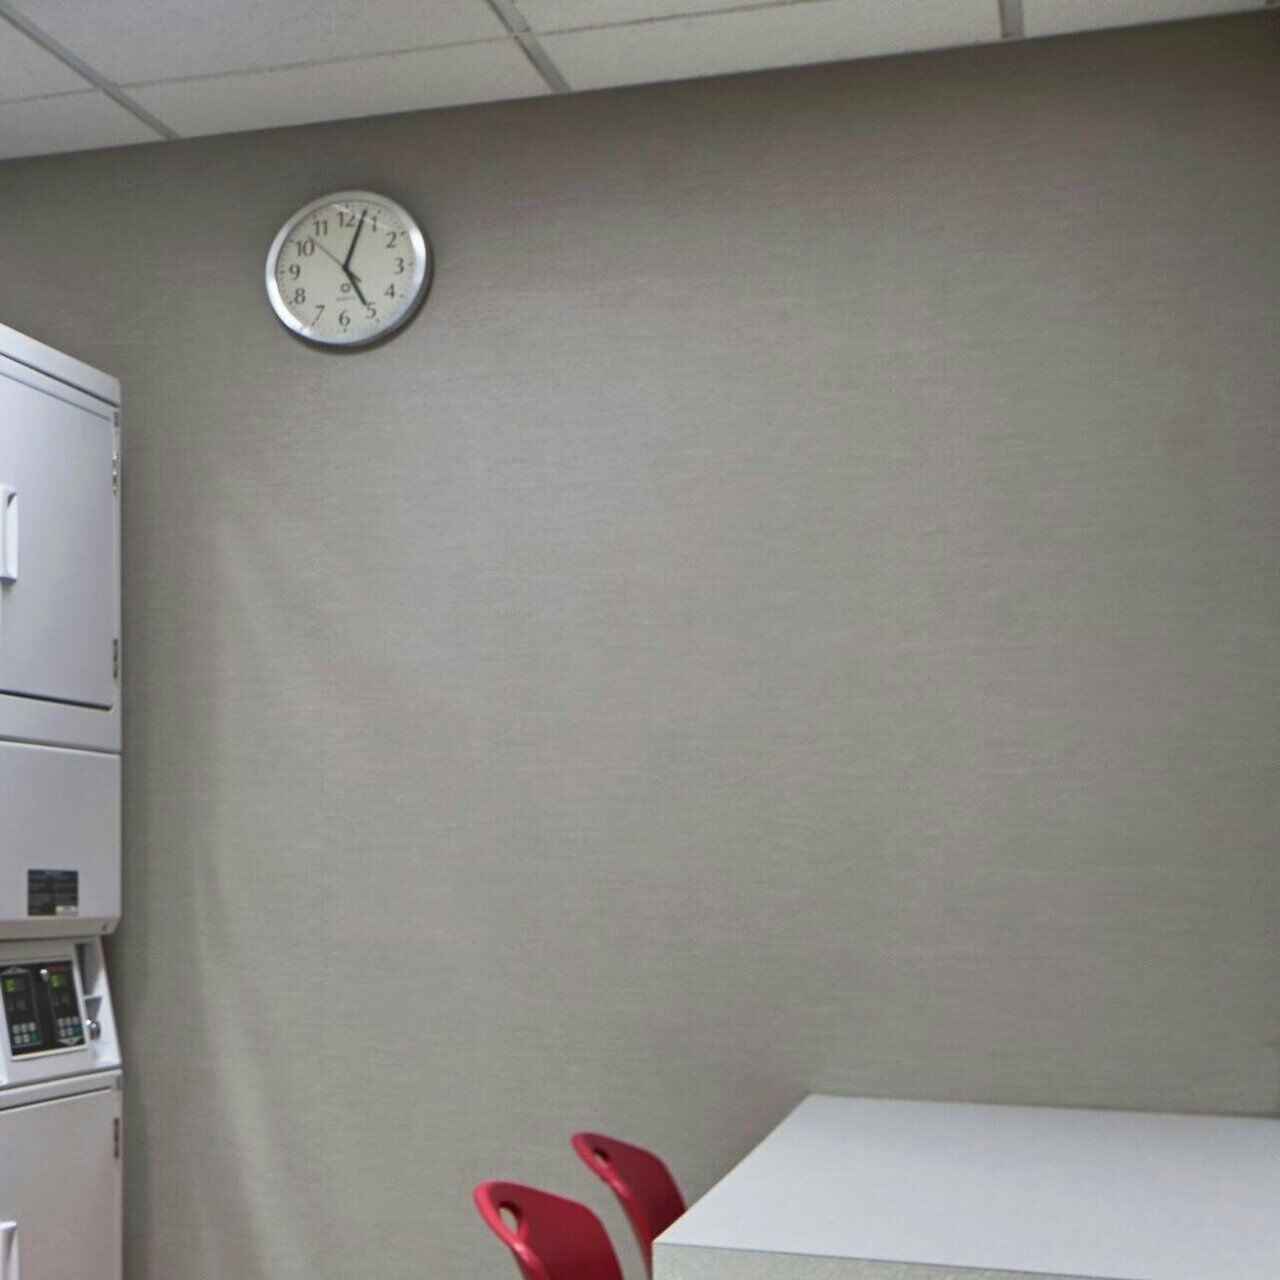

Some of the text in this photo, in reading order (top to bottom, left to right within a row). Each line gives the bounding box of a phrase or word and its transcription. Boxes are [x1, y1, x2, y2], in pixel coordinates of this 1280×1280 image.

[313, 219, 328, 236] 11
[337, 211, 356, 228] 12
[371, 215, 378, 232] 1
[296, 239, 315, 256] 10
[386, 231, 397, 249] 2
[289, 264, 301, 280] 9
[394, 258, 405, 274] 3
[294, 288, 306, 304] 8
[385, 283, 395, 299] 4
[312, 305, 325, 326] 7
[339, 309, 350, 327] 6
[366, 302, 377, 319] 5
